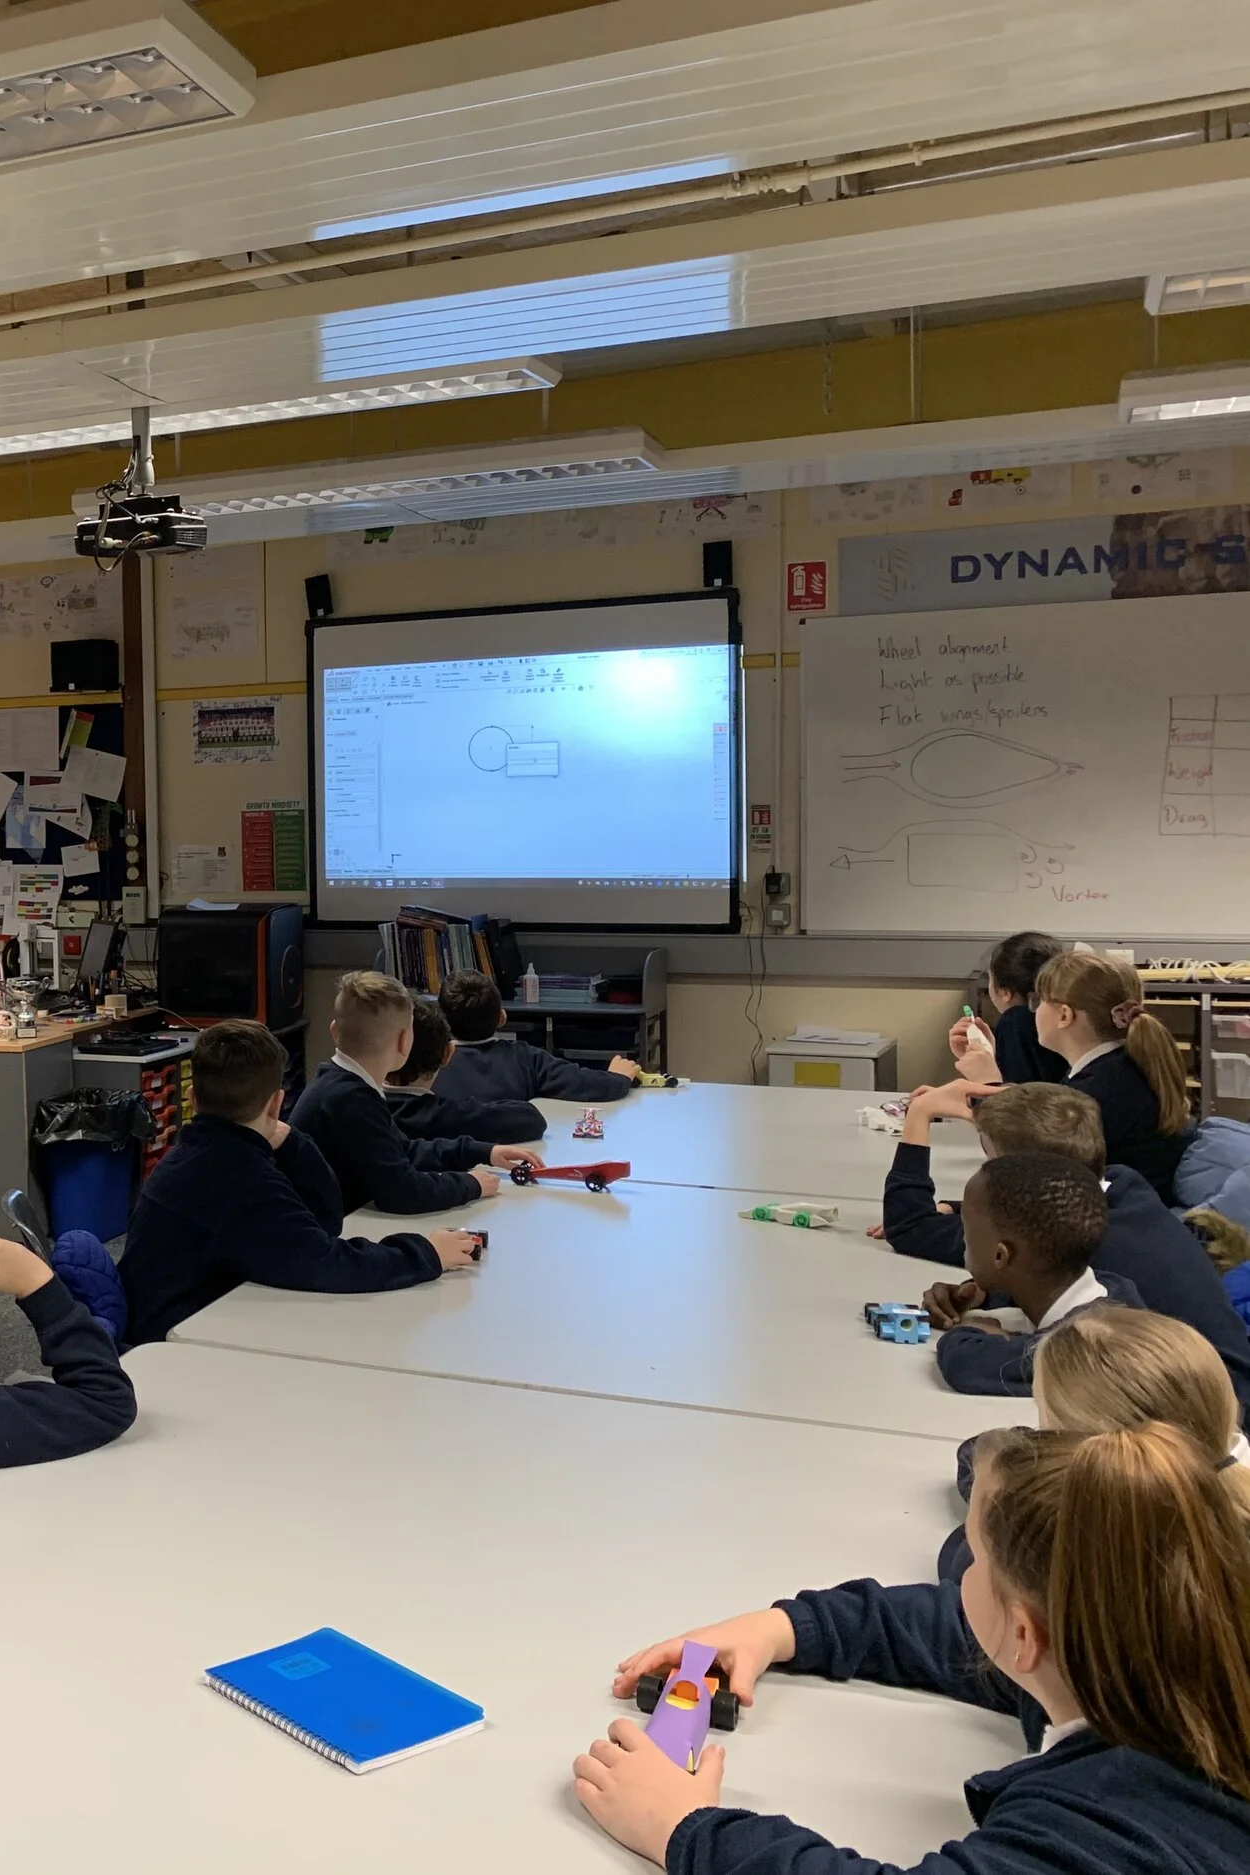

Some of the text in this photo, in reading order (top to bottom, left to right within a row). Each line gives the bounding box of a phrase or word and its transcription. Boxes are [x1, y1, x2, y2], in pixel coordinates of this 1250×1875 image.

[950, 538, 1187, 584] DYNAMIC
[877, 635, 1010, 663] Wheel alignment
[880, 664, 1028, 701] Light as possible
[878, 700, 1048, 727] Flat wings/spoilers
[1163, 804, 1208, 828] Drag
[1052, 885, 1109, 902] Vortex
